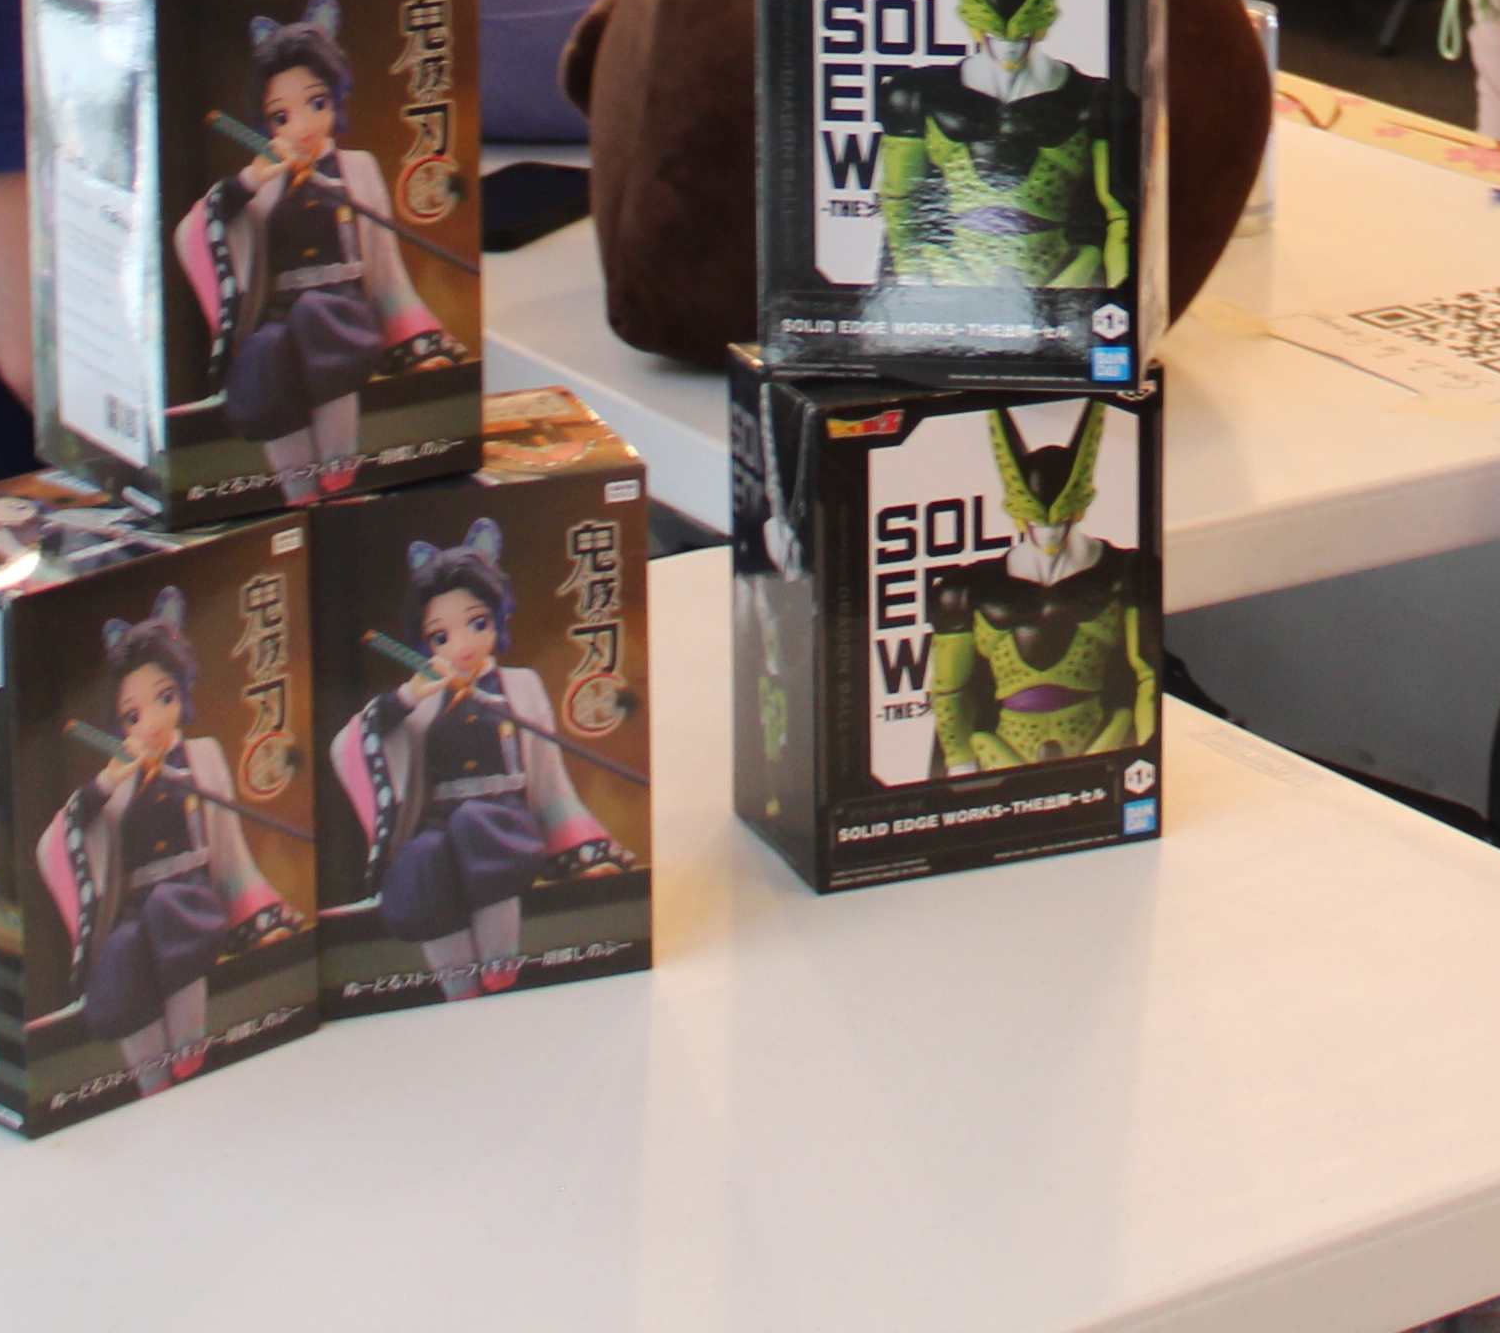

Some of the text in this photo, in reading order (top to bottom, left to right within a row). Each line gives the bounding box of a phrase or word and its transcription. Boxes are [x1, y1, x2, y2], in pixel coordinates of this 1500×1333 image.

[837, 318, 889, 334] EDGE
[876, 495, 1024, 564] SOL
[838, 824, 889, 843] SOLID
[893, 815, 937, 835] EDGE
